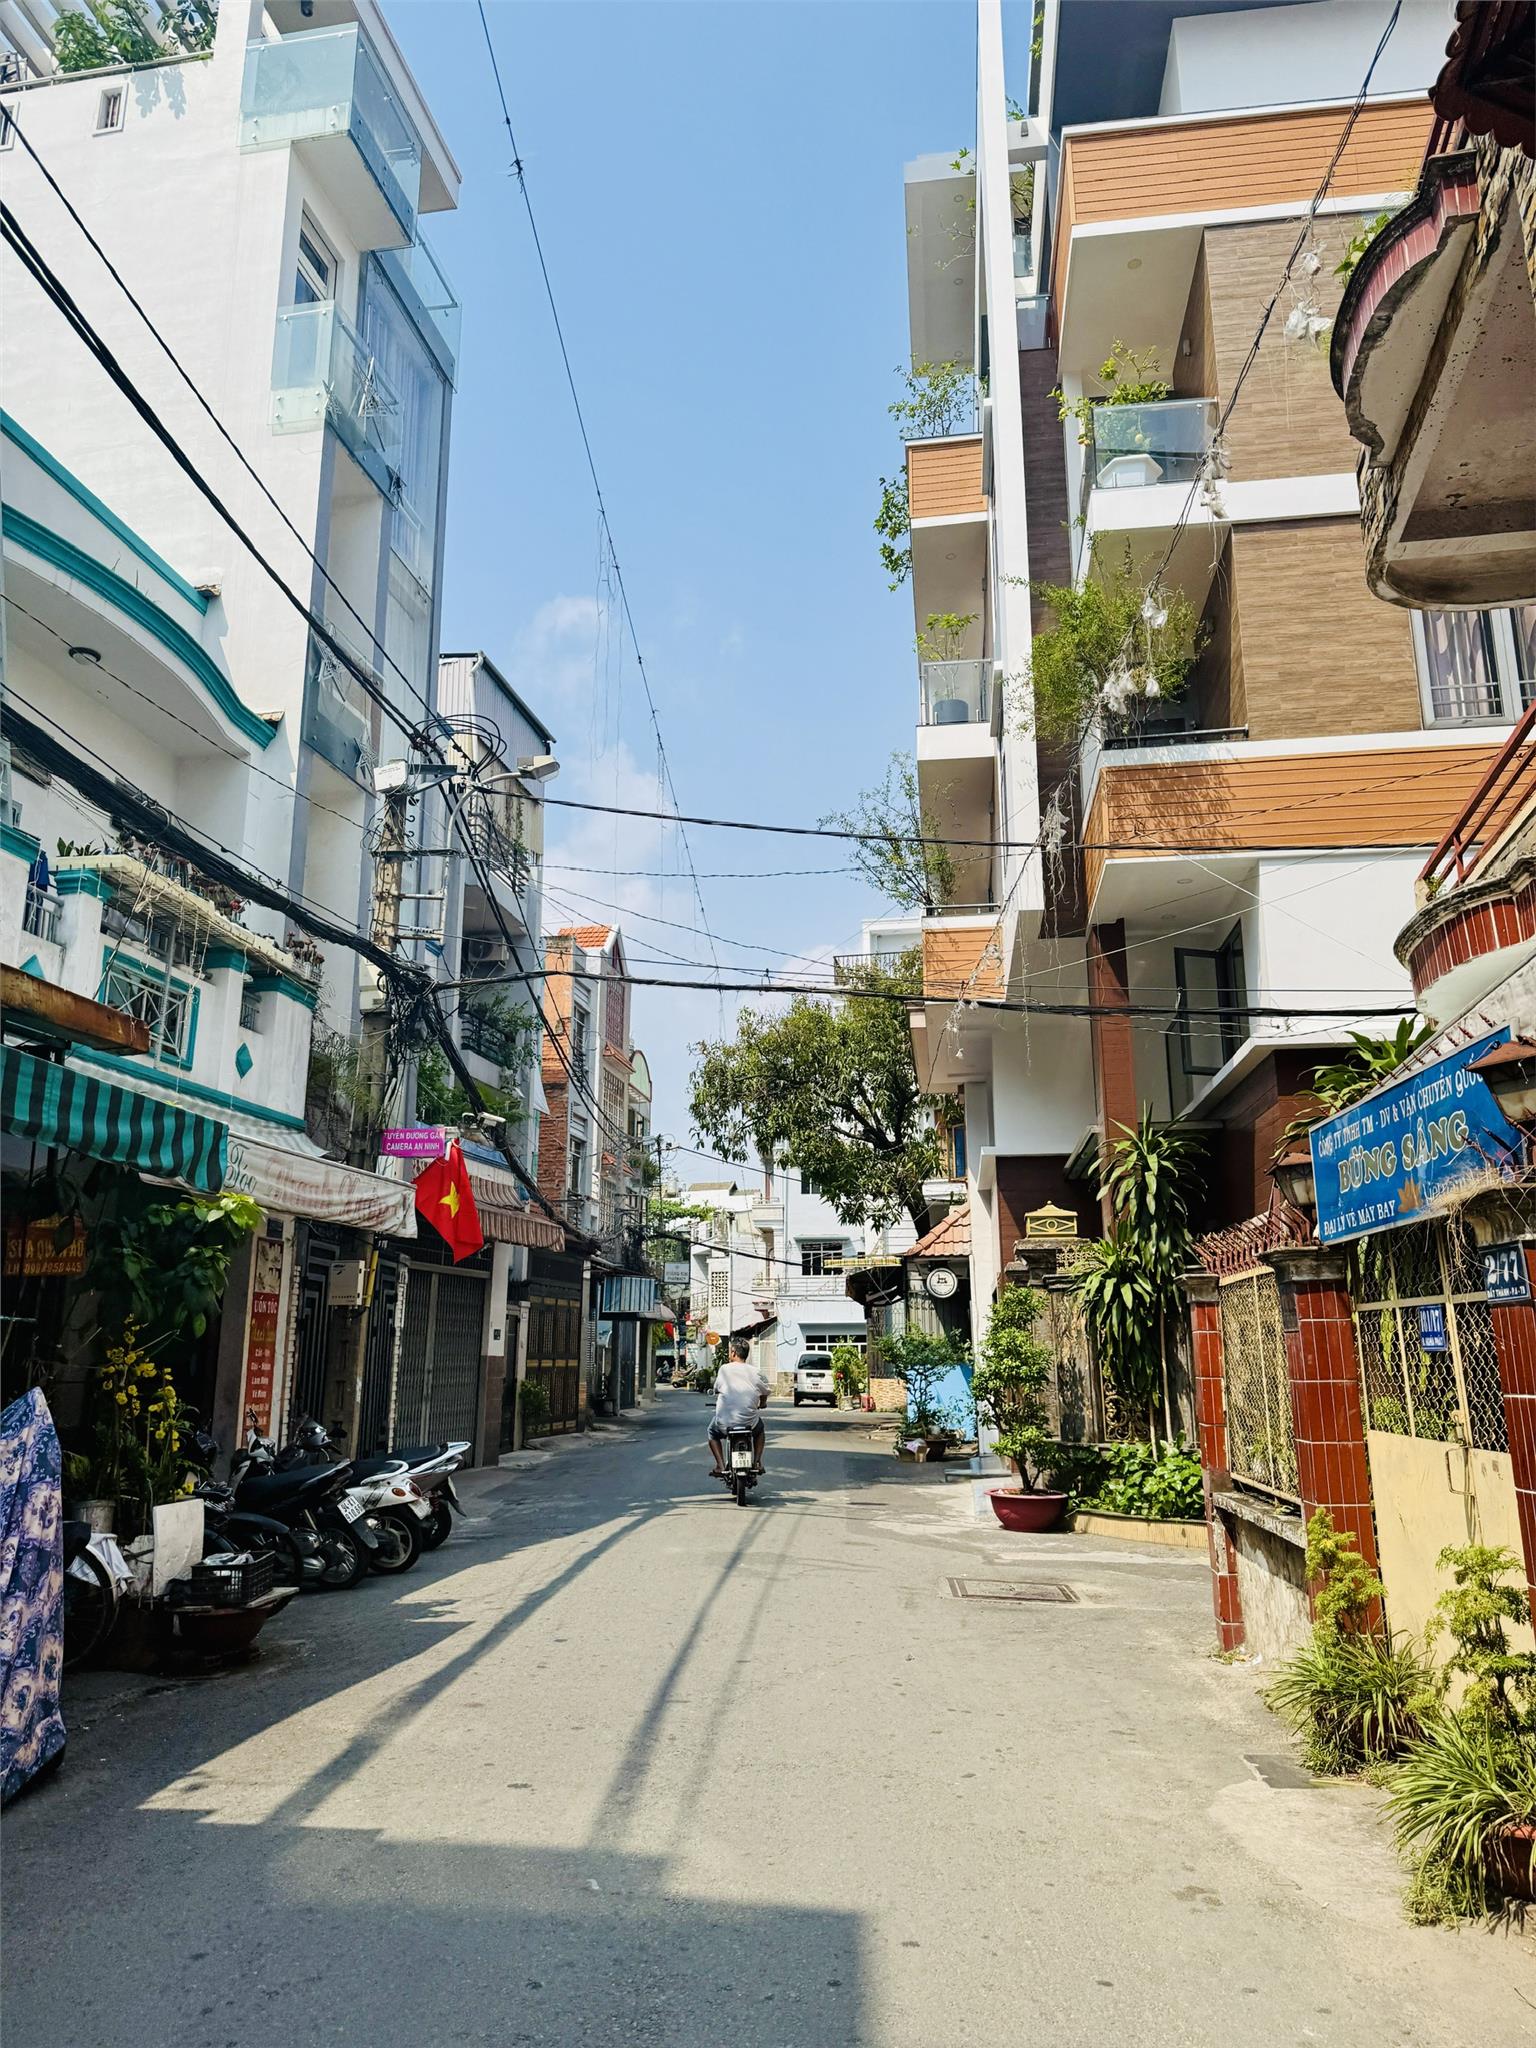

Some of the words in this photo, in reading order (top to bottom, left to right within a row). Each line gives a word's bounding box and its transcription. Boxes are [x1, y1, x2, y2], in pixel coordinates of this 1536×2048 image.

[1361, 1115, 1375, 1136] TM
[1379, 1106, 1391, 1129] DV
[1392, 1103, 1400, 1122] &
[386, 1142, 413, 1151] CAMERA
[414, 1142, 424, 1150] AN
[1401, 1109, 1469, 1171] SÁNG
[1323, 1219, 1337, 1238] ĐẠI
[1337, 1211, 1346, 1232] LÝ
[1346, 1207, 1357, 1228] VÉ
[1358, 1203, 1376, 1225] MÁY
[1377, 1199, 1396, 1220] BAY
